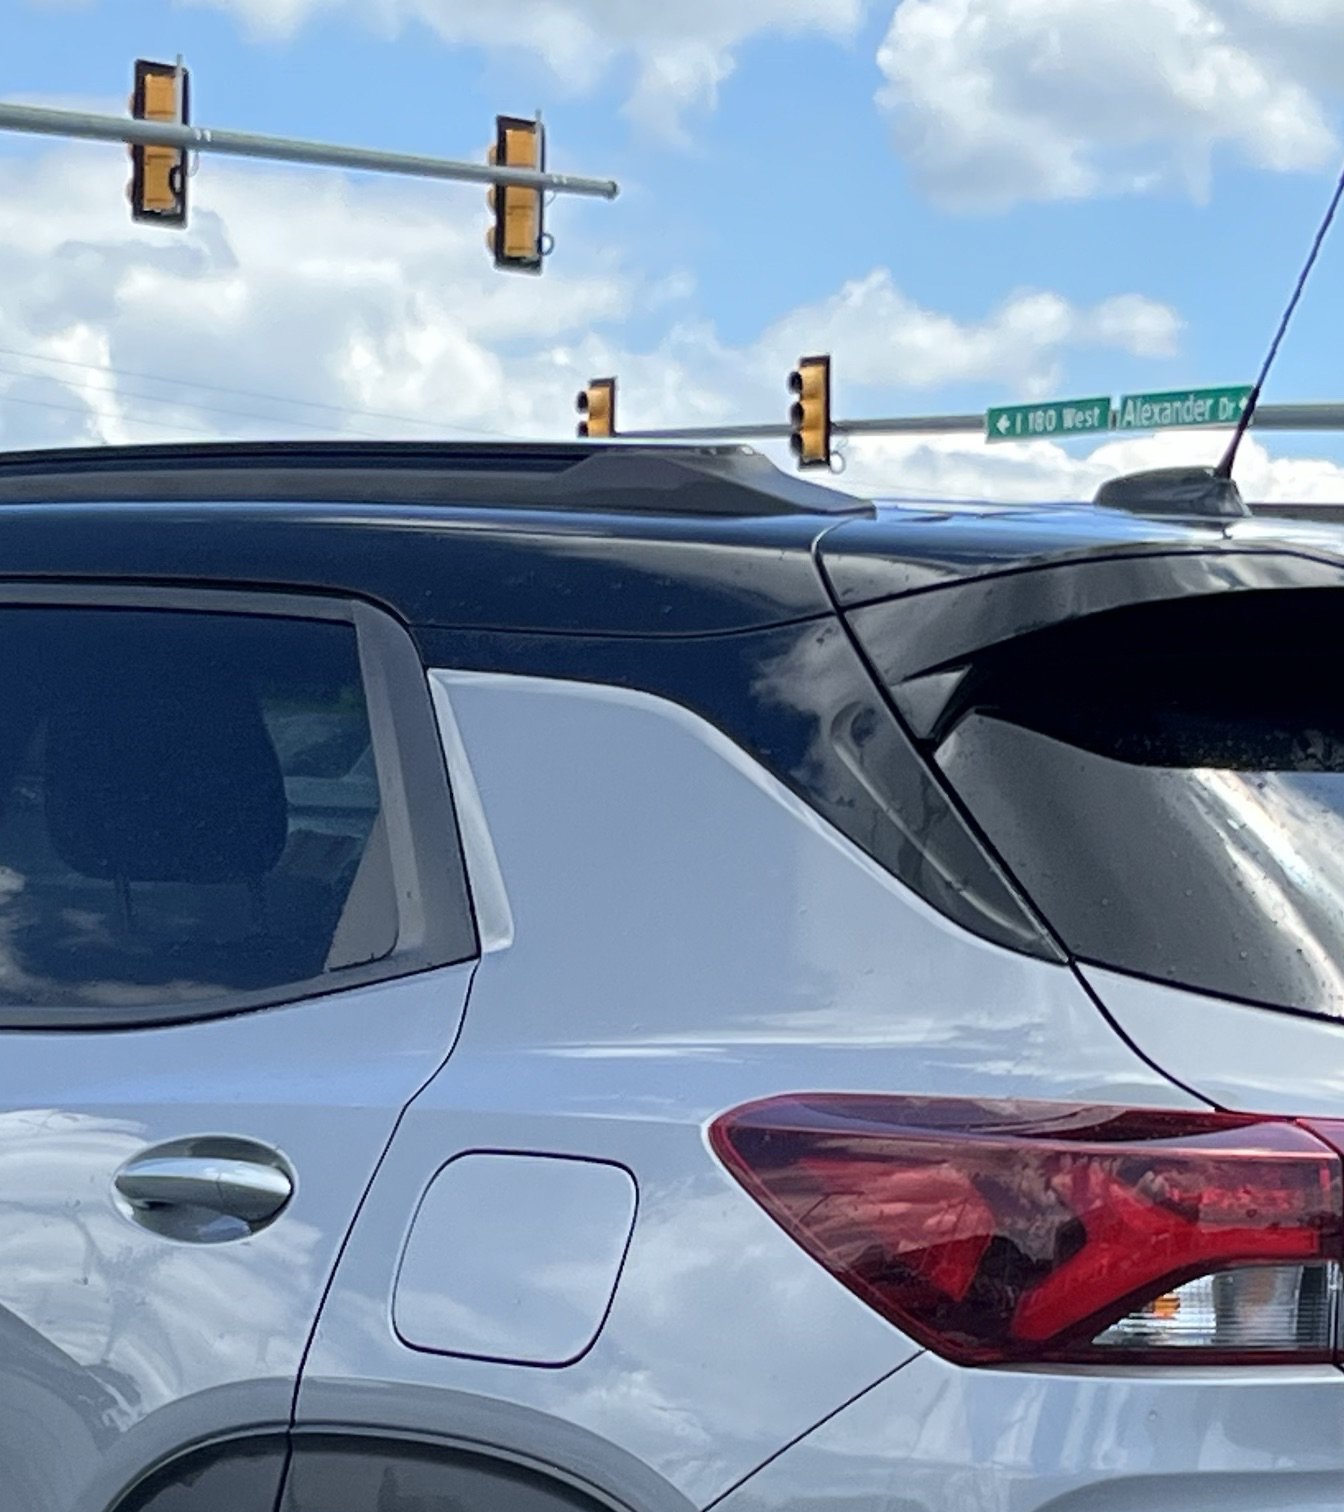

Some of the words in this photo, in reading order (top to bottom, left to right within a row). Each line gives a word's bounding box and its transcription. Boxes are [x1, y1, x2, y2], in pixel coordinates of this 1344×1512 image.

[1029, 409, 1055, 432] 180
[1063, 406, 1101, 430] West
[1120, 394, 1214, 427] Alexander
[1218, 397, 1236, 421] Dr
